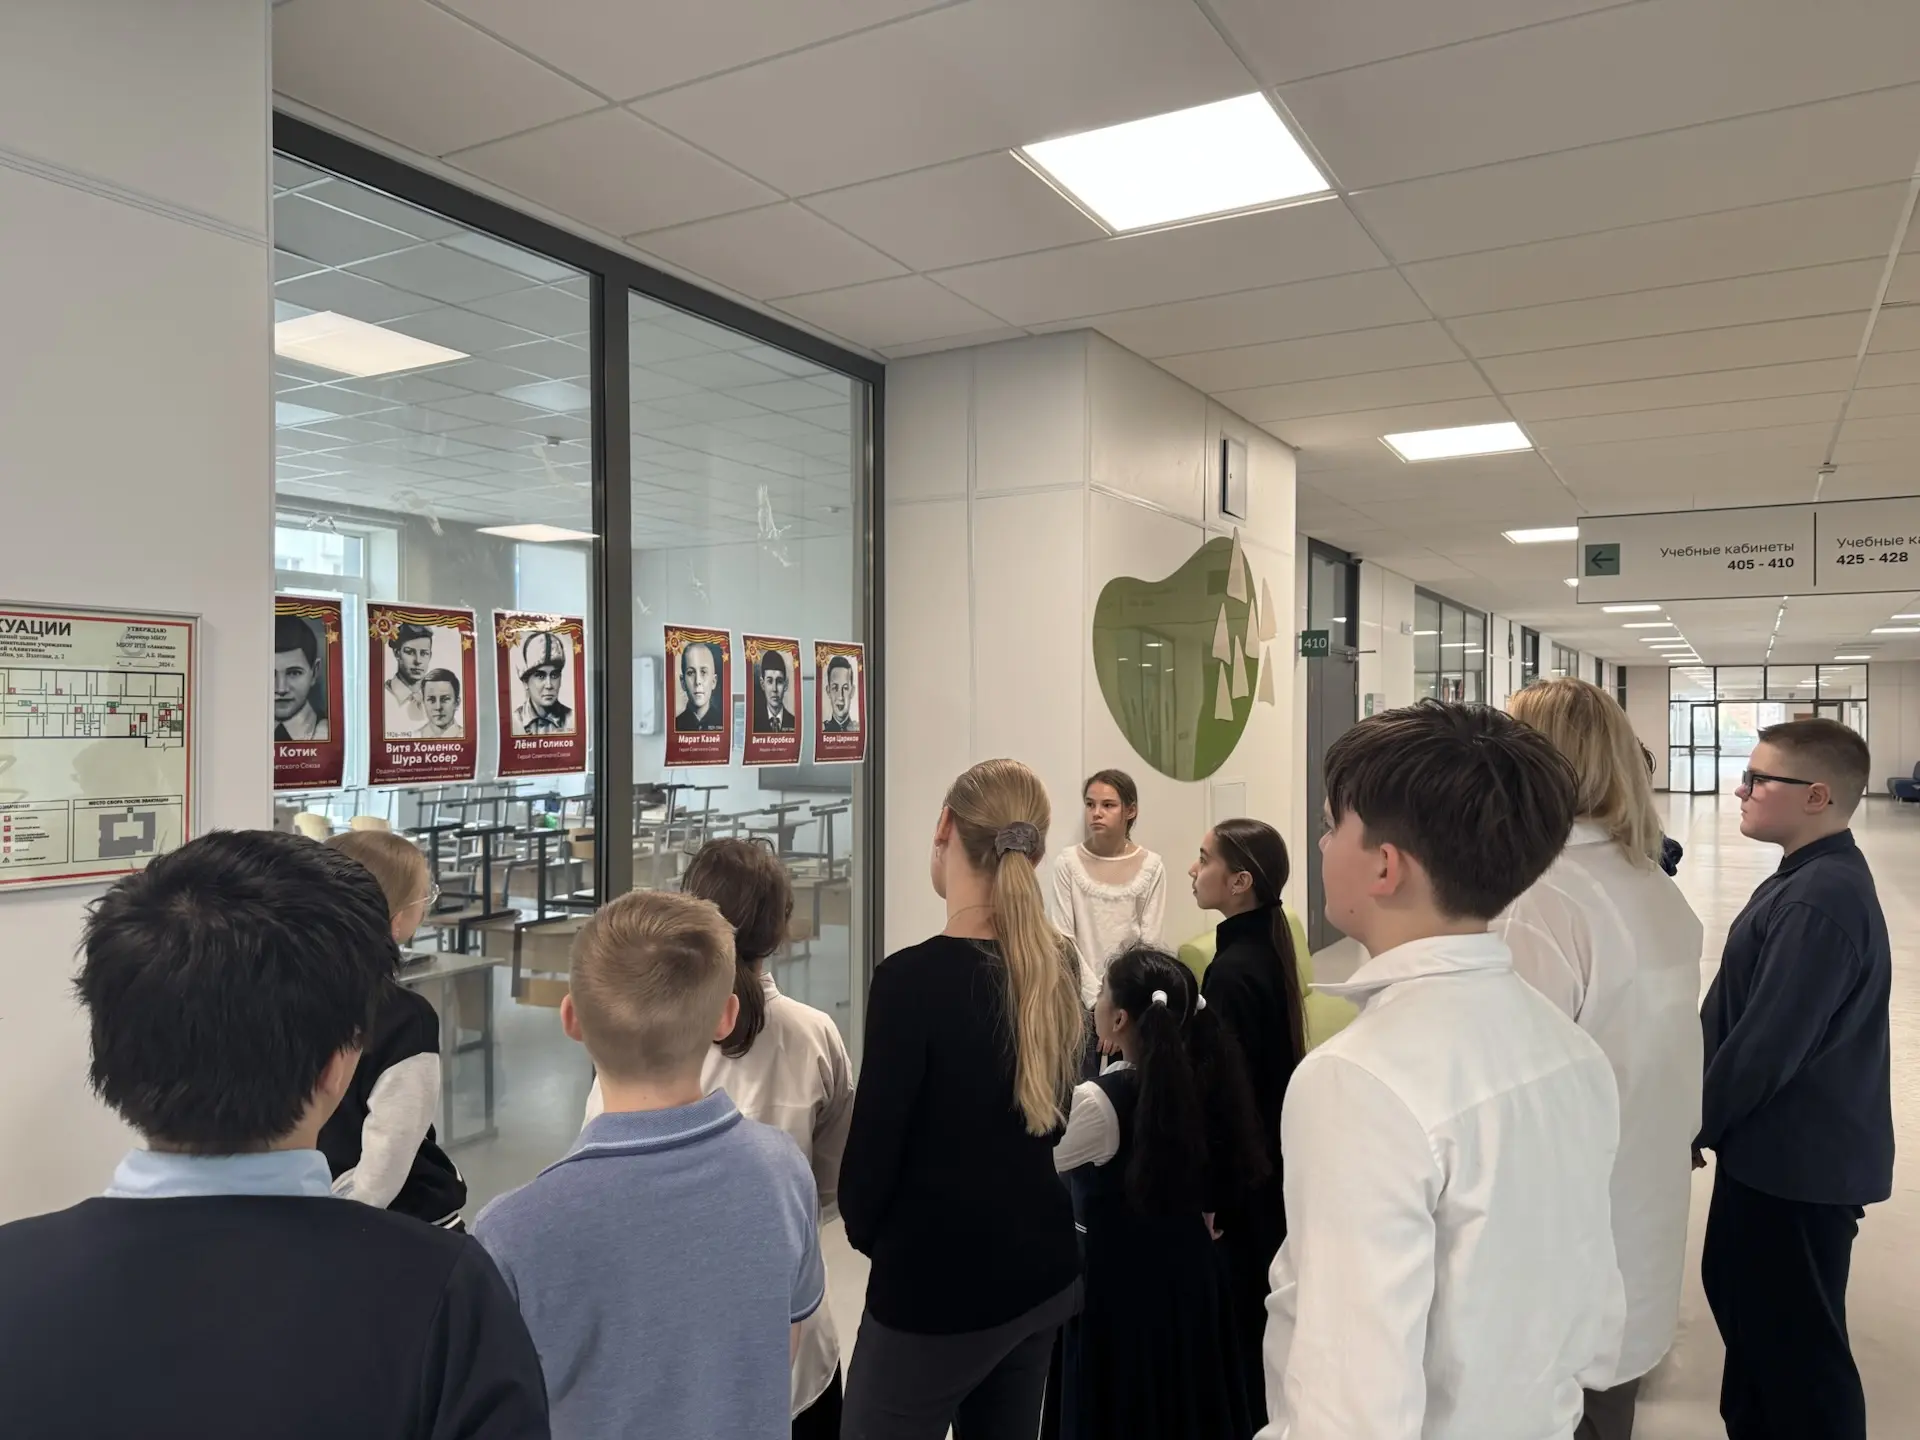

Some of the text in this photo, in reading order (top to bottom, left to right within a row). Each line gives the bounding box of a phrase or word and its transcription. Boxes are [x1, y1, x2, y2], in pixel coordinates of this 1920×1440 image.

[1836, 536, 1904, 549] Учебные
[1660, 543, 1794, 557] Учебные кабинеты
[1727, 559, 1755, 570] 405
[1768, 557, 1795, 568] 410
[1836, 554, 1865, 565] 425
[1878, 551, 1909, 563] 428
[0, 618, 71, 637] УАЦИИ
[1304, 638, 1327, 648] 410
[514, 739, 574, 750] Лёня Голиков
[678, 734, 720, 745] Марат Казей
[752, 736, 795, 745] Витя Коробков
[823, 735, 836, 744] Боря
[279, 746, 318, 757] Котик
[386, 743, 464, 754] Витя Хоменко,
[392, 753, 458, 766] Шура Кобер
